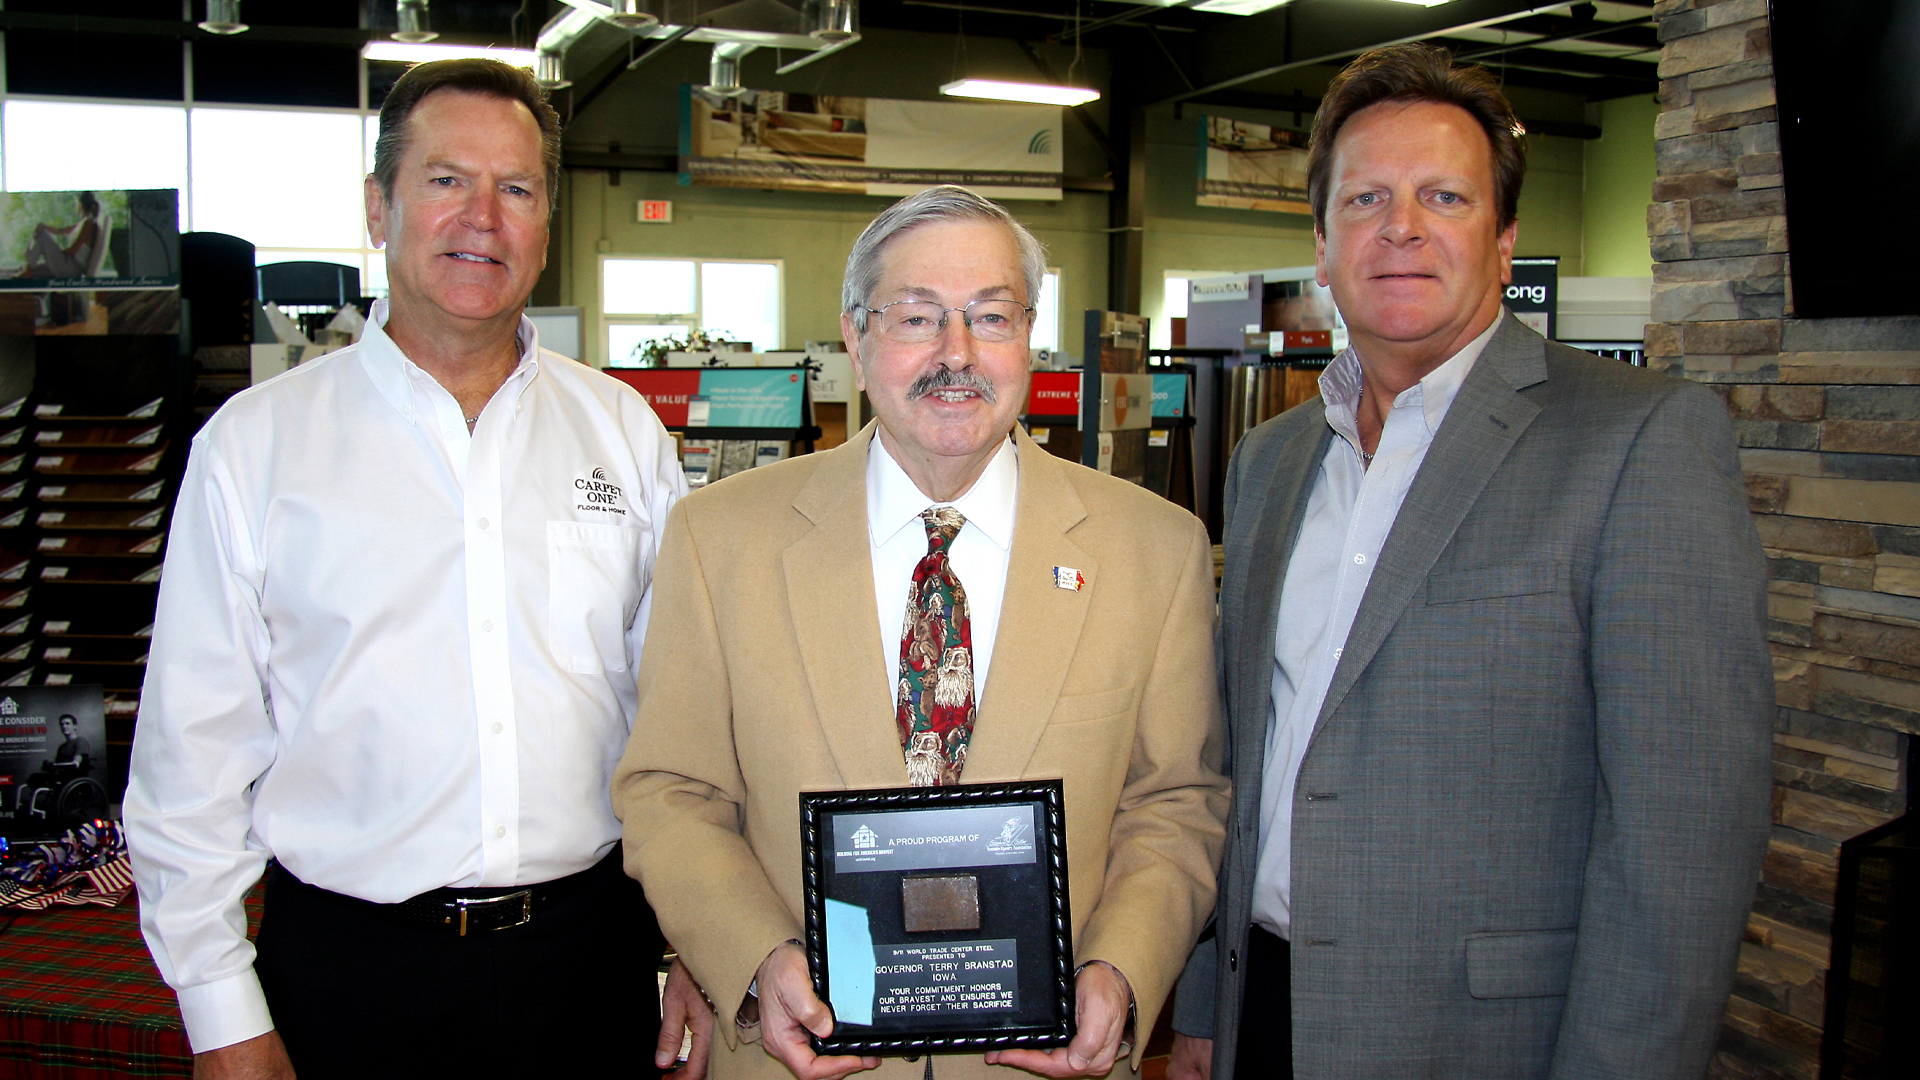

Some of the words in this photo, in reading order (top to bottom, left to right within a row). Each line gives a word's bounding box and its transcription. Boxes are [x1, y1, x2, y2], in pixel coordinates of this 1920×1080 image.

[644, 201, 666, 219] EXIT
[656, 394, 688, 404] VALUE
[1037, 391, 1072, 399] EXTREME
[574, 478, 623, 497] CARPET
[608, 507, 626, 516] HOME
[4, 716, 46, 726] CONSIDER
[888, 838, 895, 846] A
[896, 838, 924, 846] PROUD
[926, 834, 966, 844] PROGRAM
[968, 834, 980, 842] OF
[875, 964, 924, 974] GOVERNOR
[930, 962, 959, 972] TERRY
[964, 960, 1014, 970] BRANSTAD
[932, 972, 957, 982] IOWA
[890, 986, 911, 996] YOUR
[914, 984, 966, 994] COMMITMENT
[970, 982, 1002, 992] HONORS
[878, 996, 896, 1005] OUR
[900, 994, 936, 1004] BRAVEST
[940, 994, 957, 1002] AND
[960, 992, 996, 1002] ENSURES
[1000, 991, 1014, 999] WE
[880, 1004, 907, 1014] NEVER
[910, 1003, 942, 1012] FORGET
[946, 1002, 969, 1010] THEIR
[972, 1000, 1014, 1009] SACRIFICE
